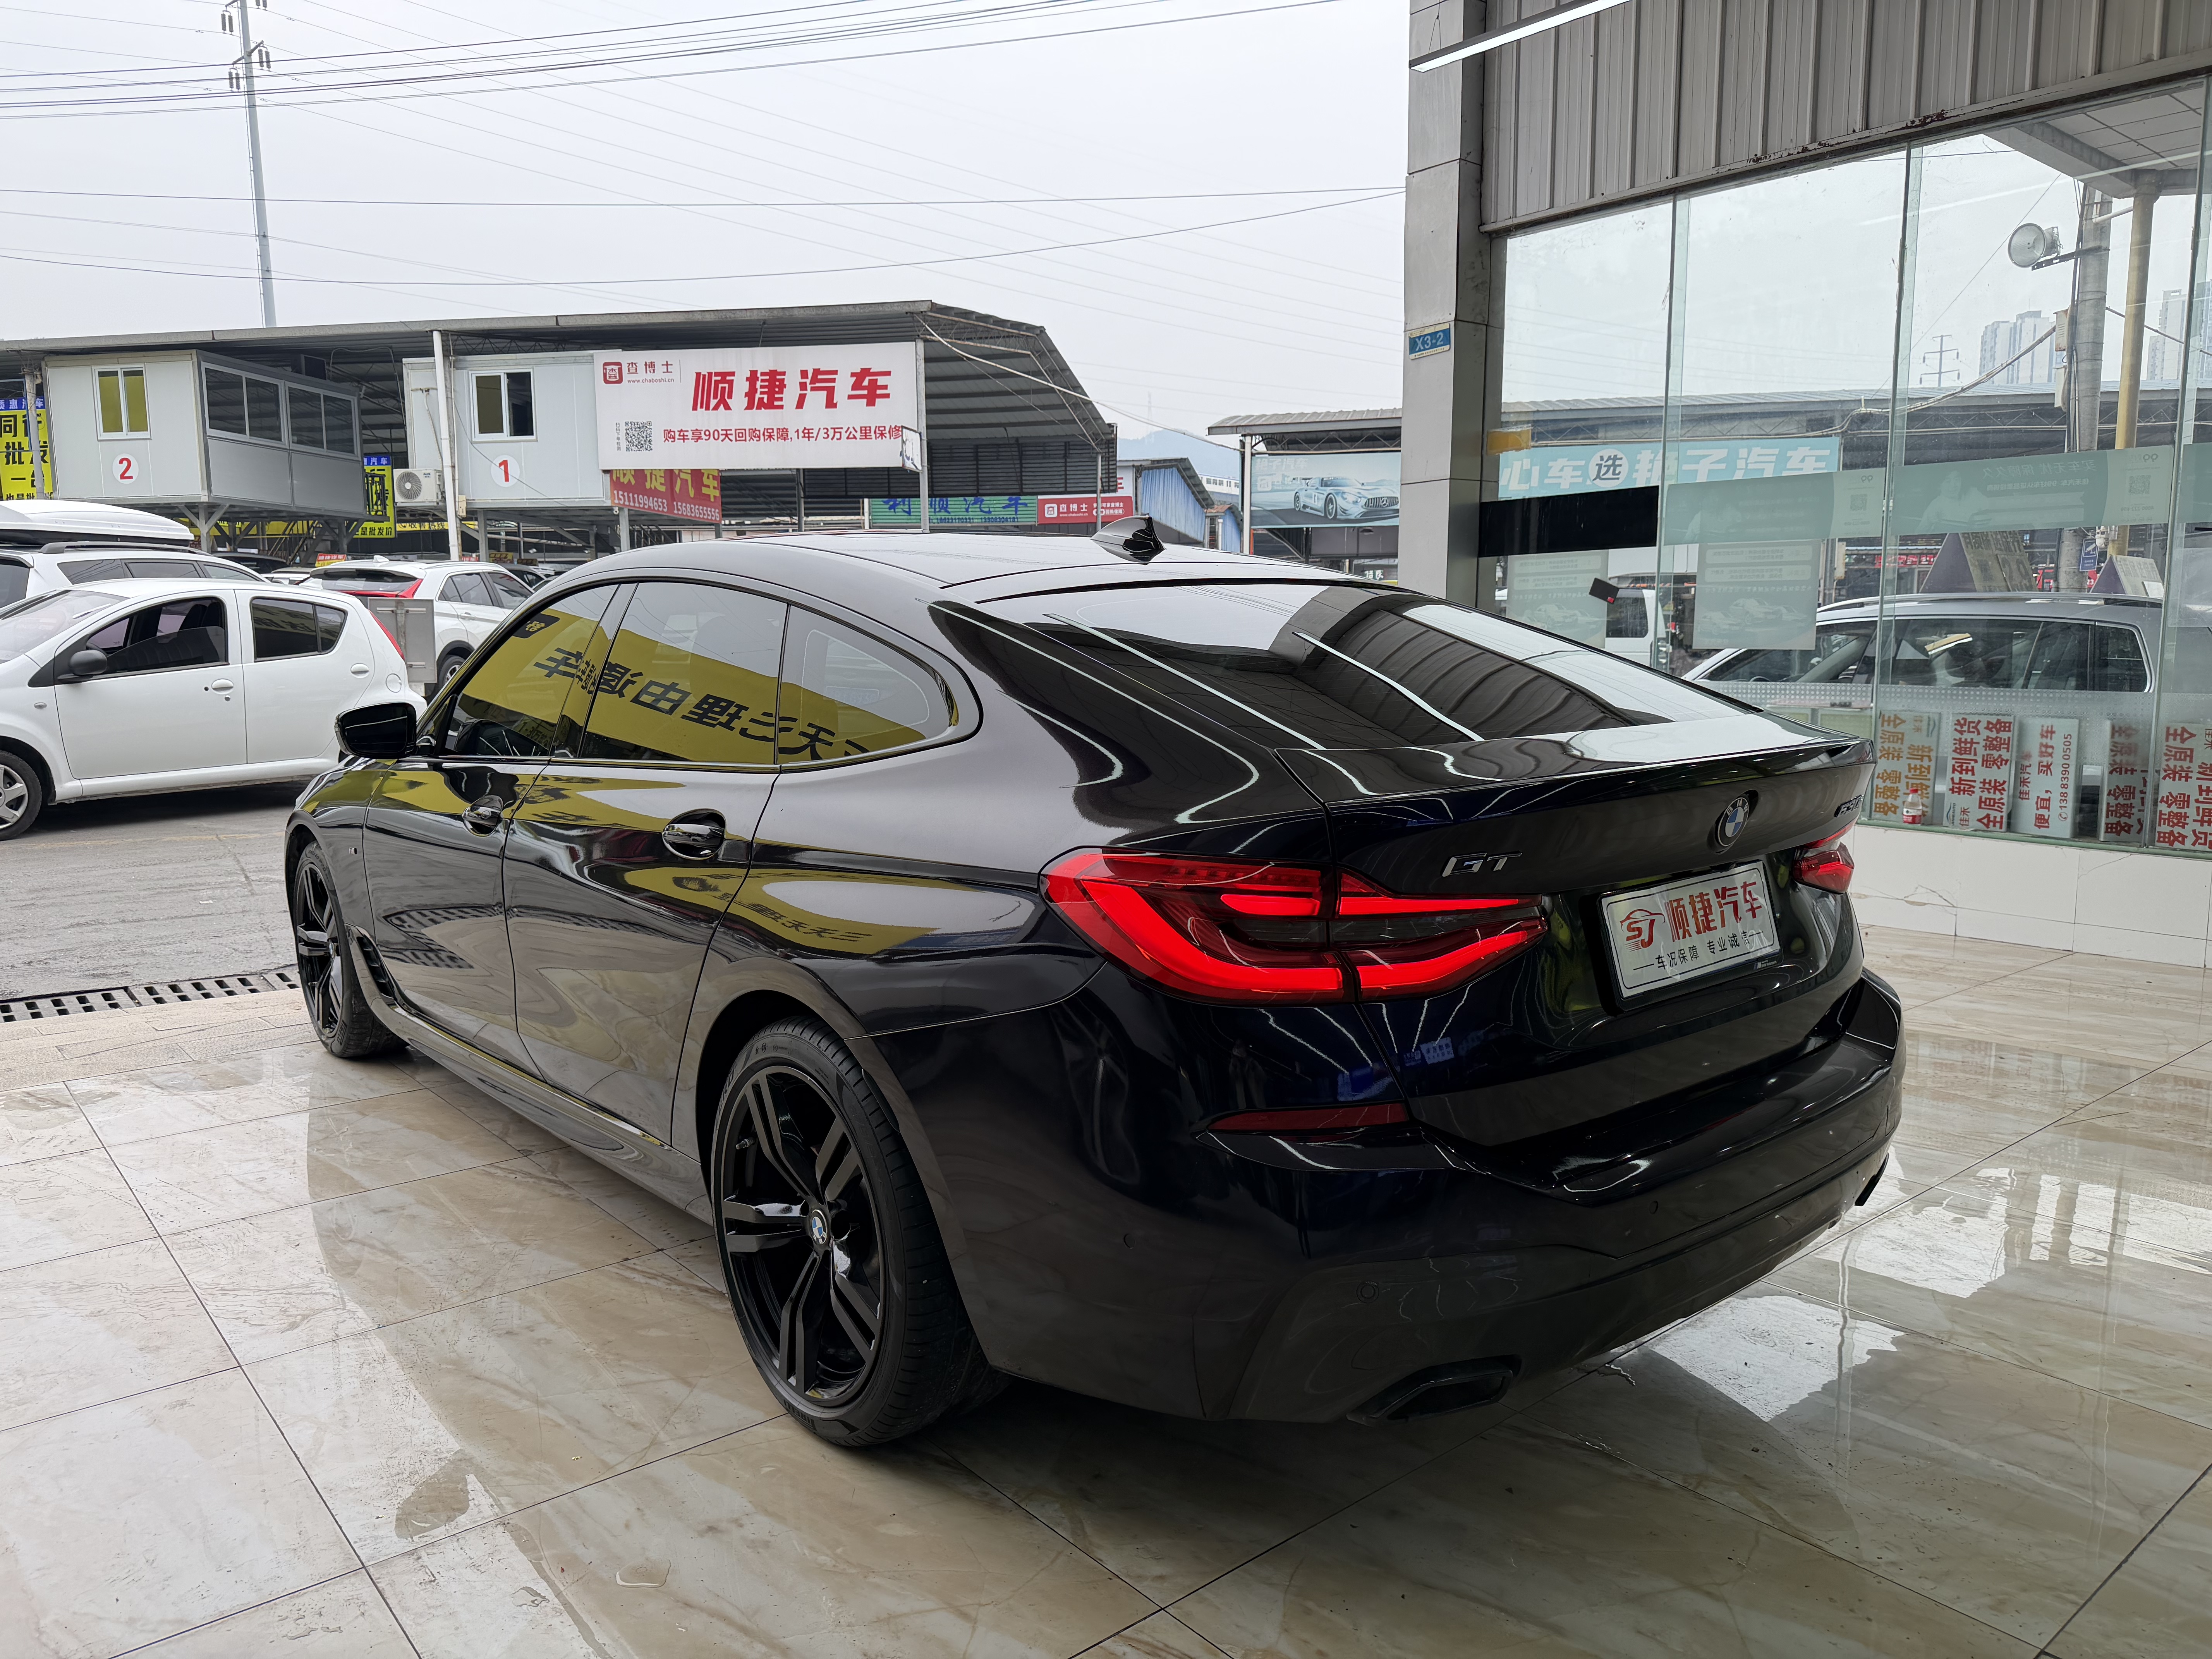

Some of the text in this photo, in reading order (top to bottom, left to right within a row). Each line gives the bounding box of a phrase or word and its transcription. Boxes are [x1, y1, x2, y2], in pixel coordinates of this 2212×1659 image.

[1415, 332, 1444, 351] X3-2
[627, 361, 673, 374] 查博士
[692, 368, 892, 411] 顺捷汽车
[118, 458, 133, 480] 2
[498, 460, 510, 483] 1
[613, 469, 720, 502] 顺捷汽车
[614, 490, 720, 521] 15111994653 15683655556
[1060, 503, 1088, 512] 查博士
[1874, 714, 1906, 816] 全原装 零整备
[1949, 717, 1982, 797] 新到鲜货
[1976, 718, 2013, 830] 全原装 零整备
[2059, 733, 2072, 810] 138 8390 0505
[2104, 724, 2140, 836] 全原装 零整备
[2156, 726, 2197, 847] 全原装 零整备
[1959, 806, 1970, 827] 佳禾
[1442, 852, 1523, 877] GT
[1665, 881, 1762, 943] 顺捷汽车
[1656, 931, 1750, 970] 车况保障 专业诚信
